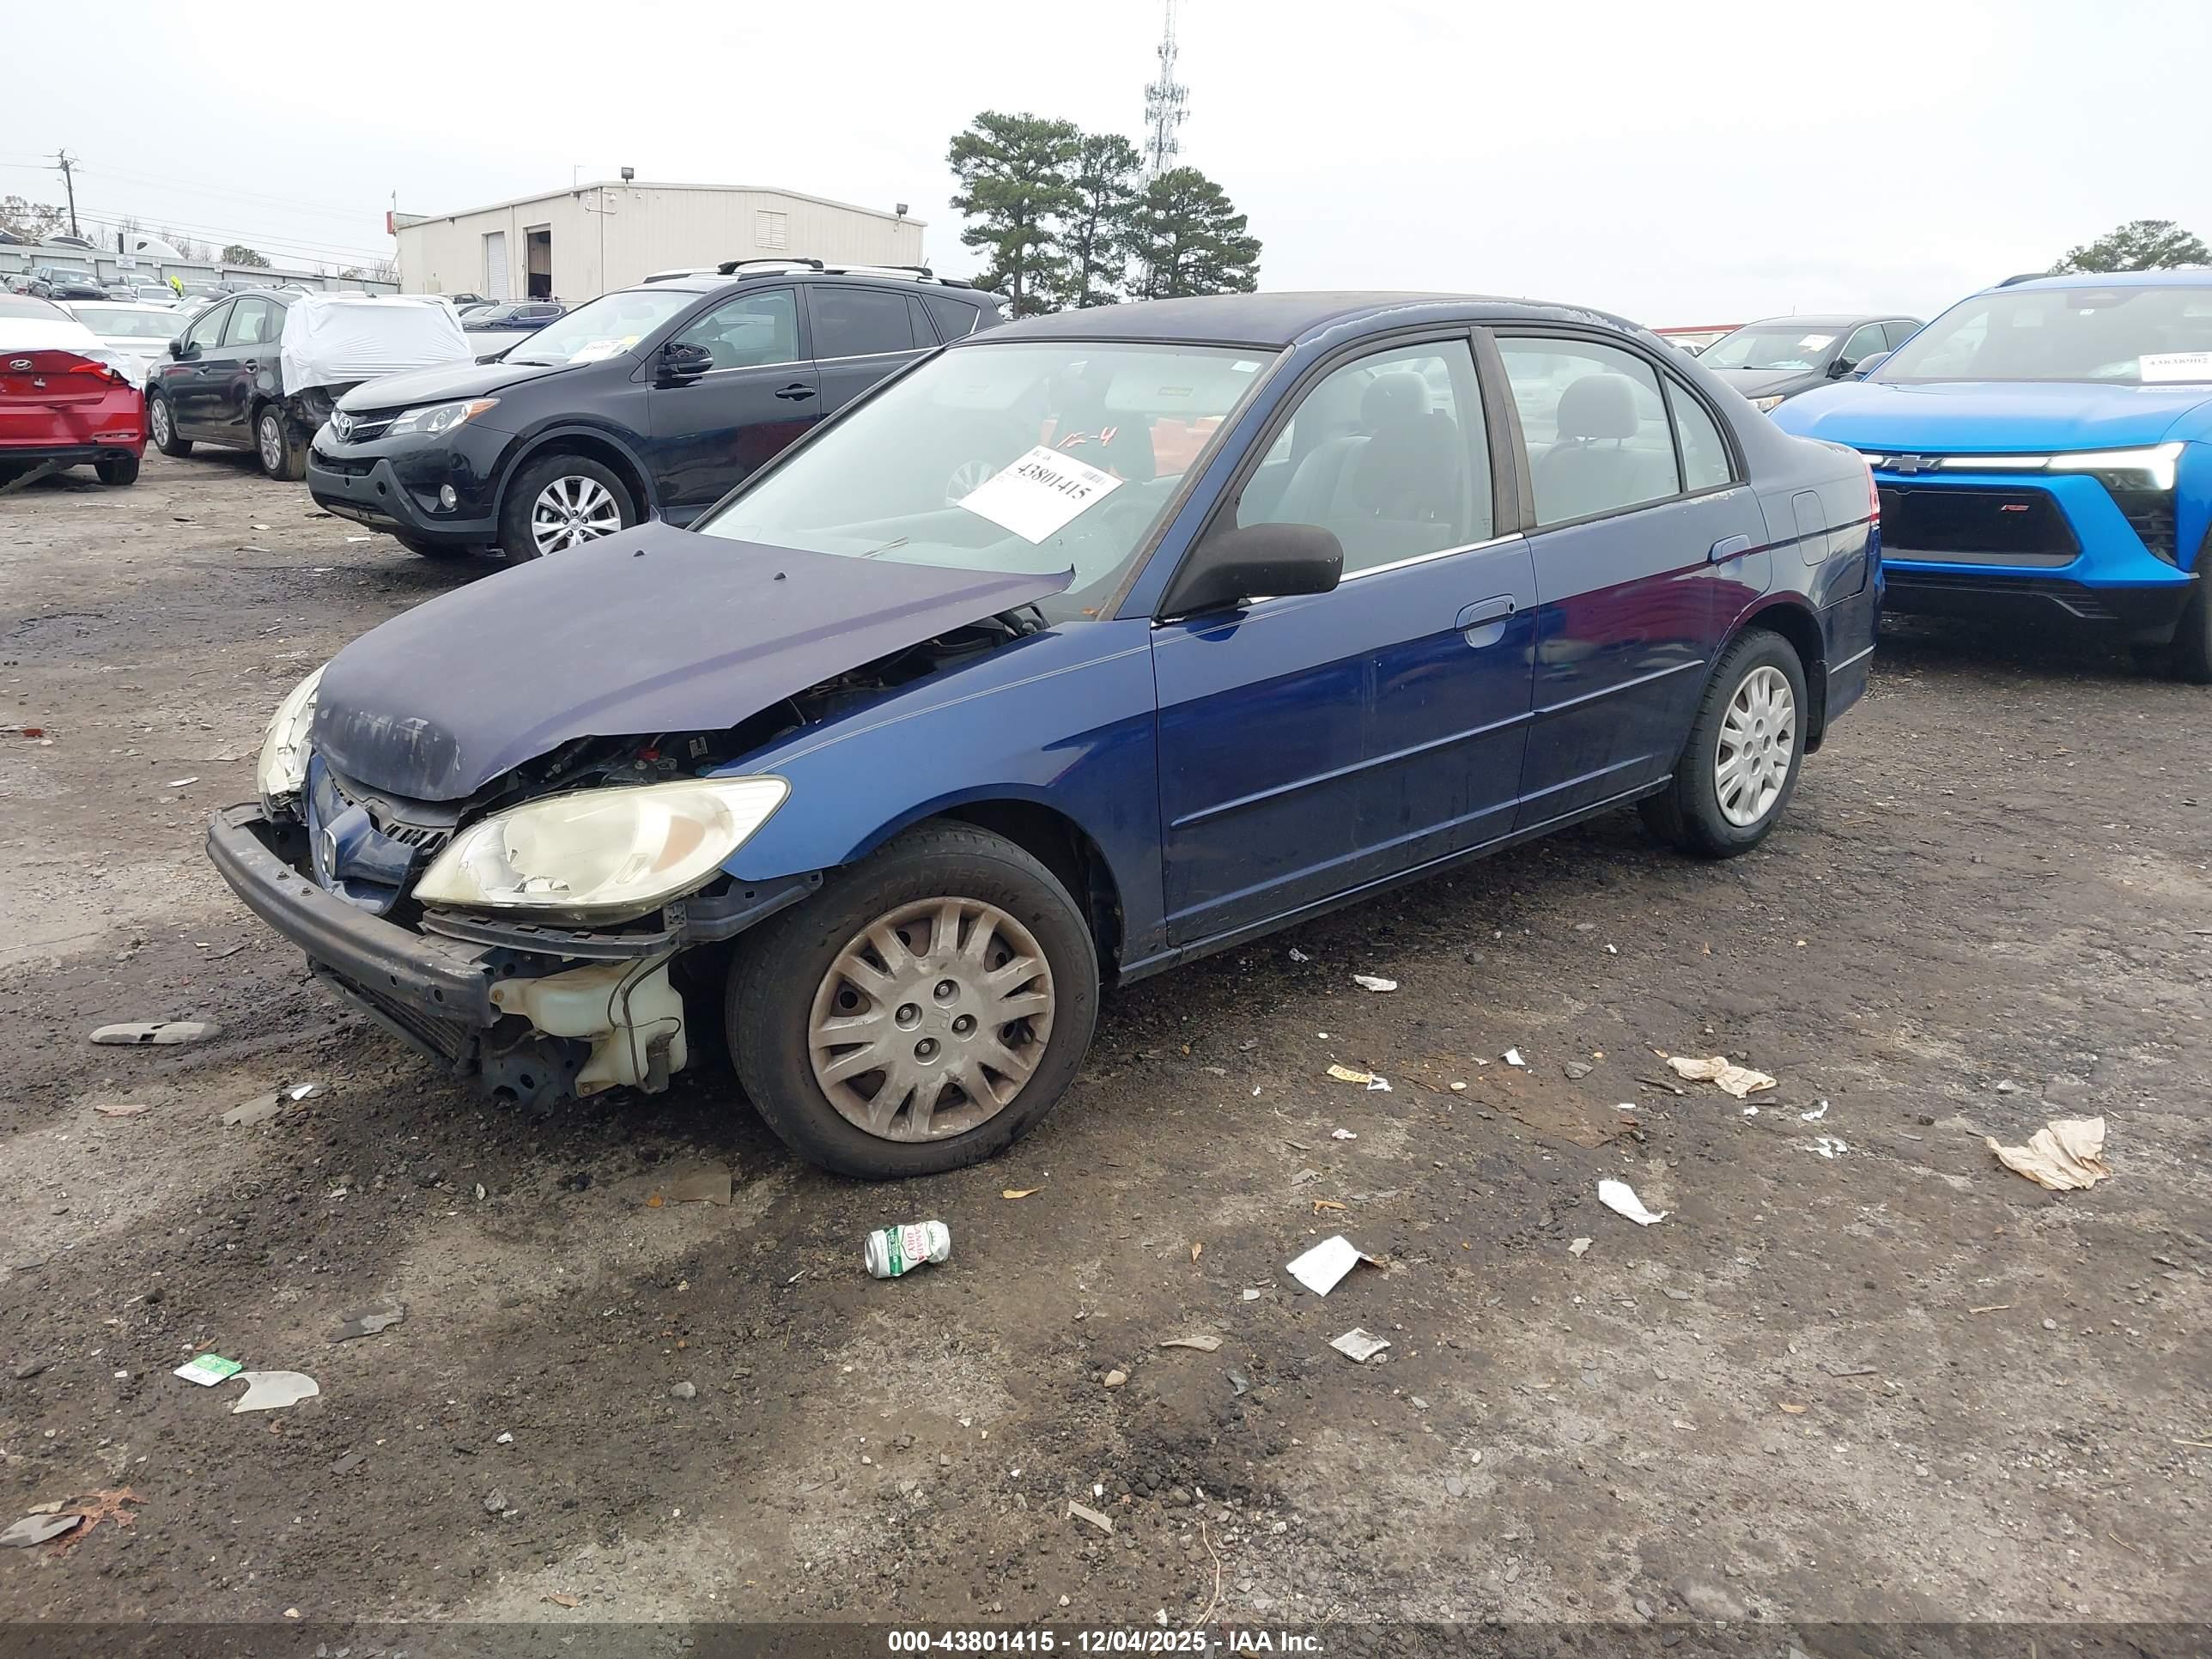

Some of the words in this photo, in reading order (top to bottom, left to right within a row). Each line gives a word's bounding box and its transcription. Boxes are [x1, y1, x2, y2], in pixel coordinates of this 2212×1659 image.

[1018, 463, 1092, 499] 43801415
[907, 1232, 915, 1253] DRY
[915, 1223, 927, 1263] CANADA
